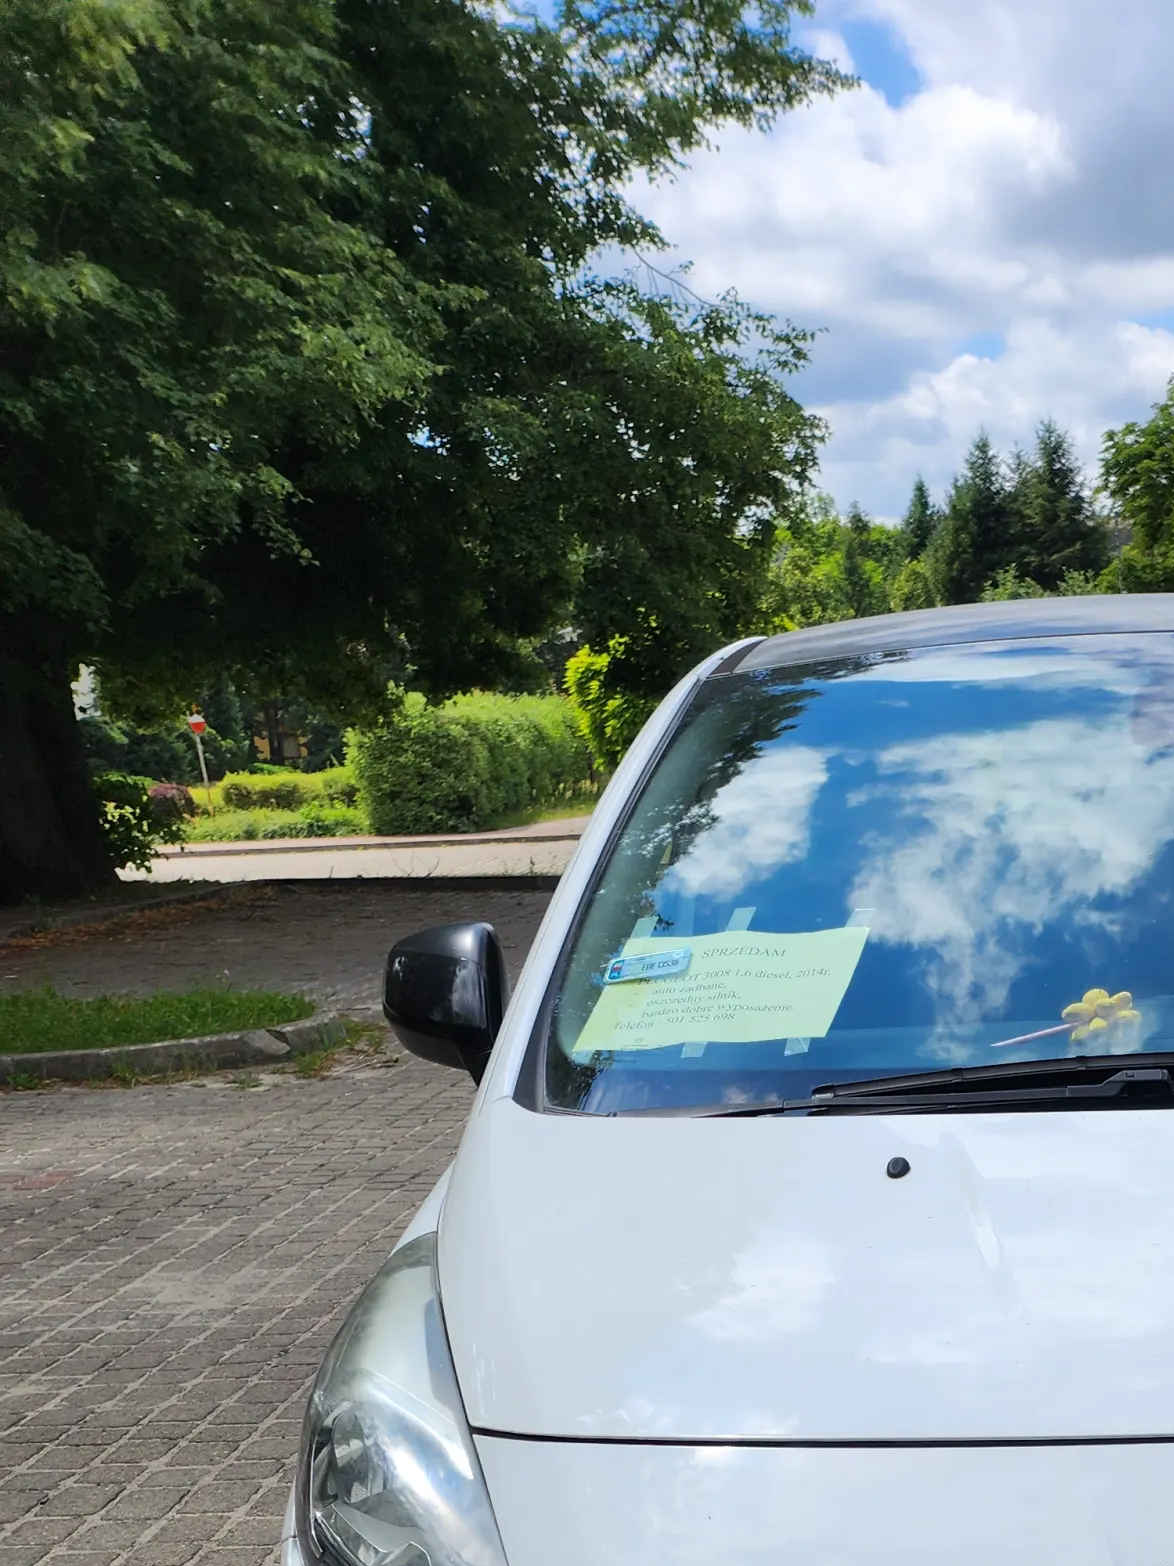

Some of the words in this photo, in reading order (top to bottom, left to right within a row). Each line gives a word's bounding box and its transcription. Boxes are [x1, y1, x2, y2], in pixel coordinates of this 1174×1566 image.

[701, 946, 788, 960] SPRZEDAM
[702, 969, 732, 980] 3008
[712, 1013, 736, 1021] 698
